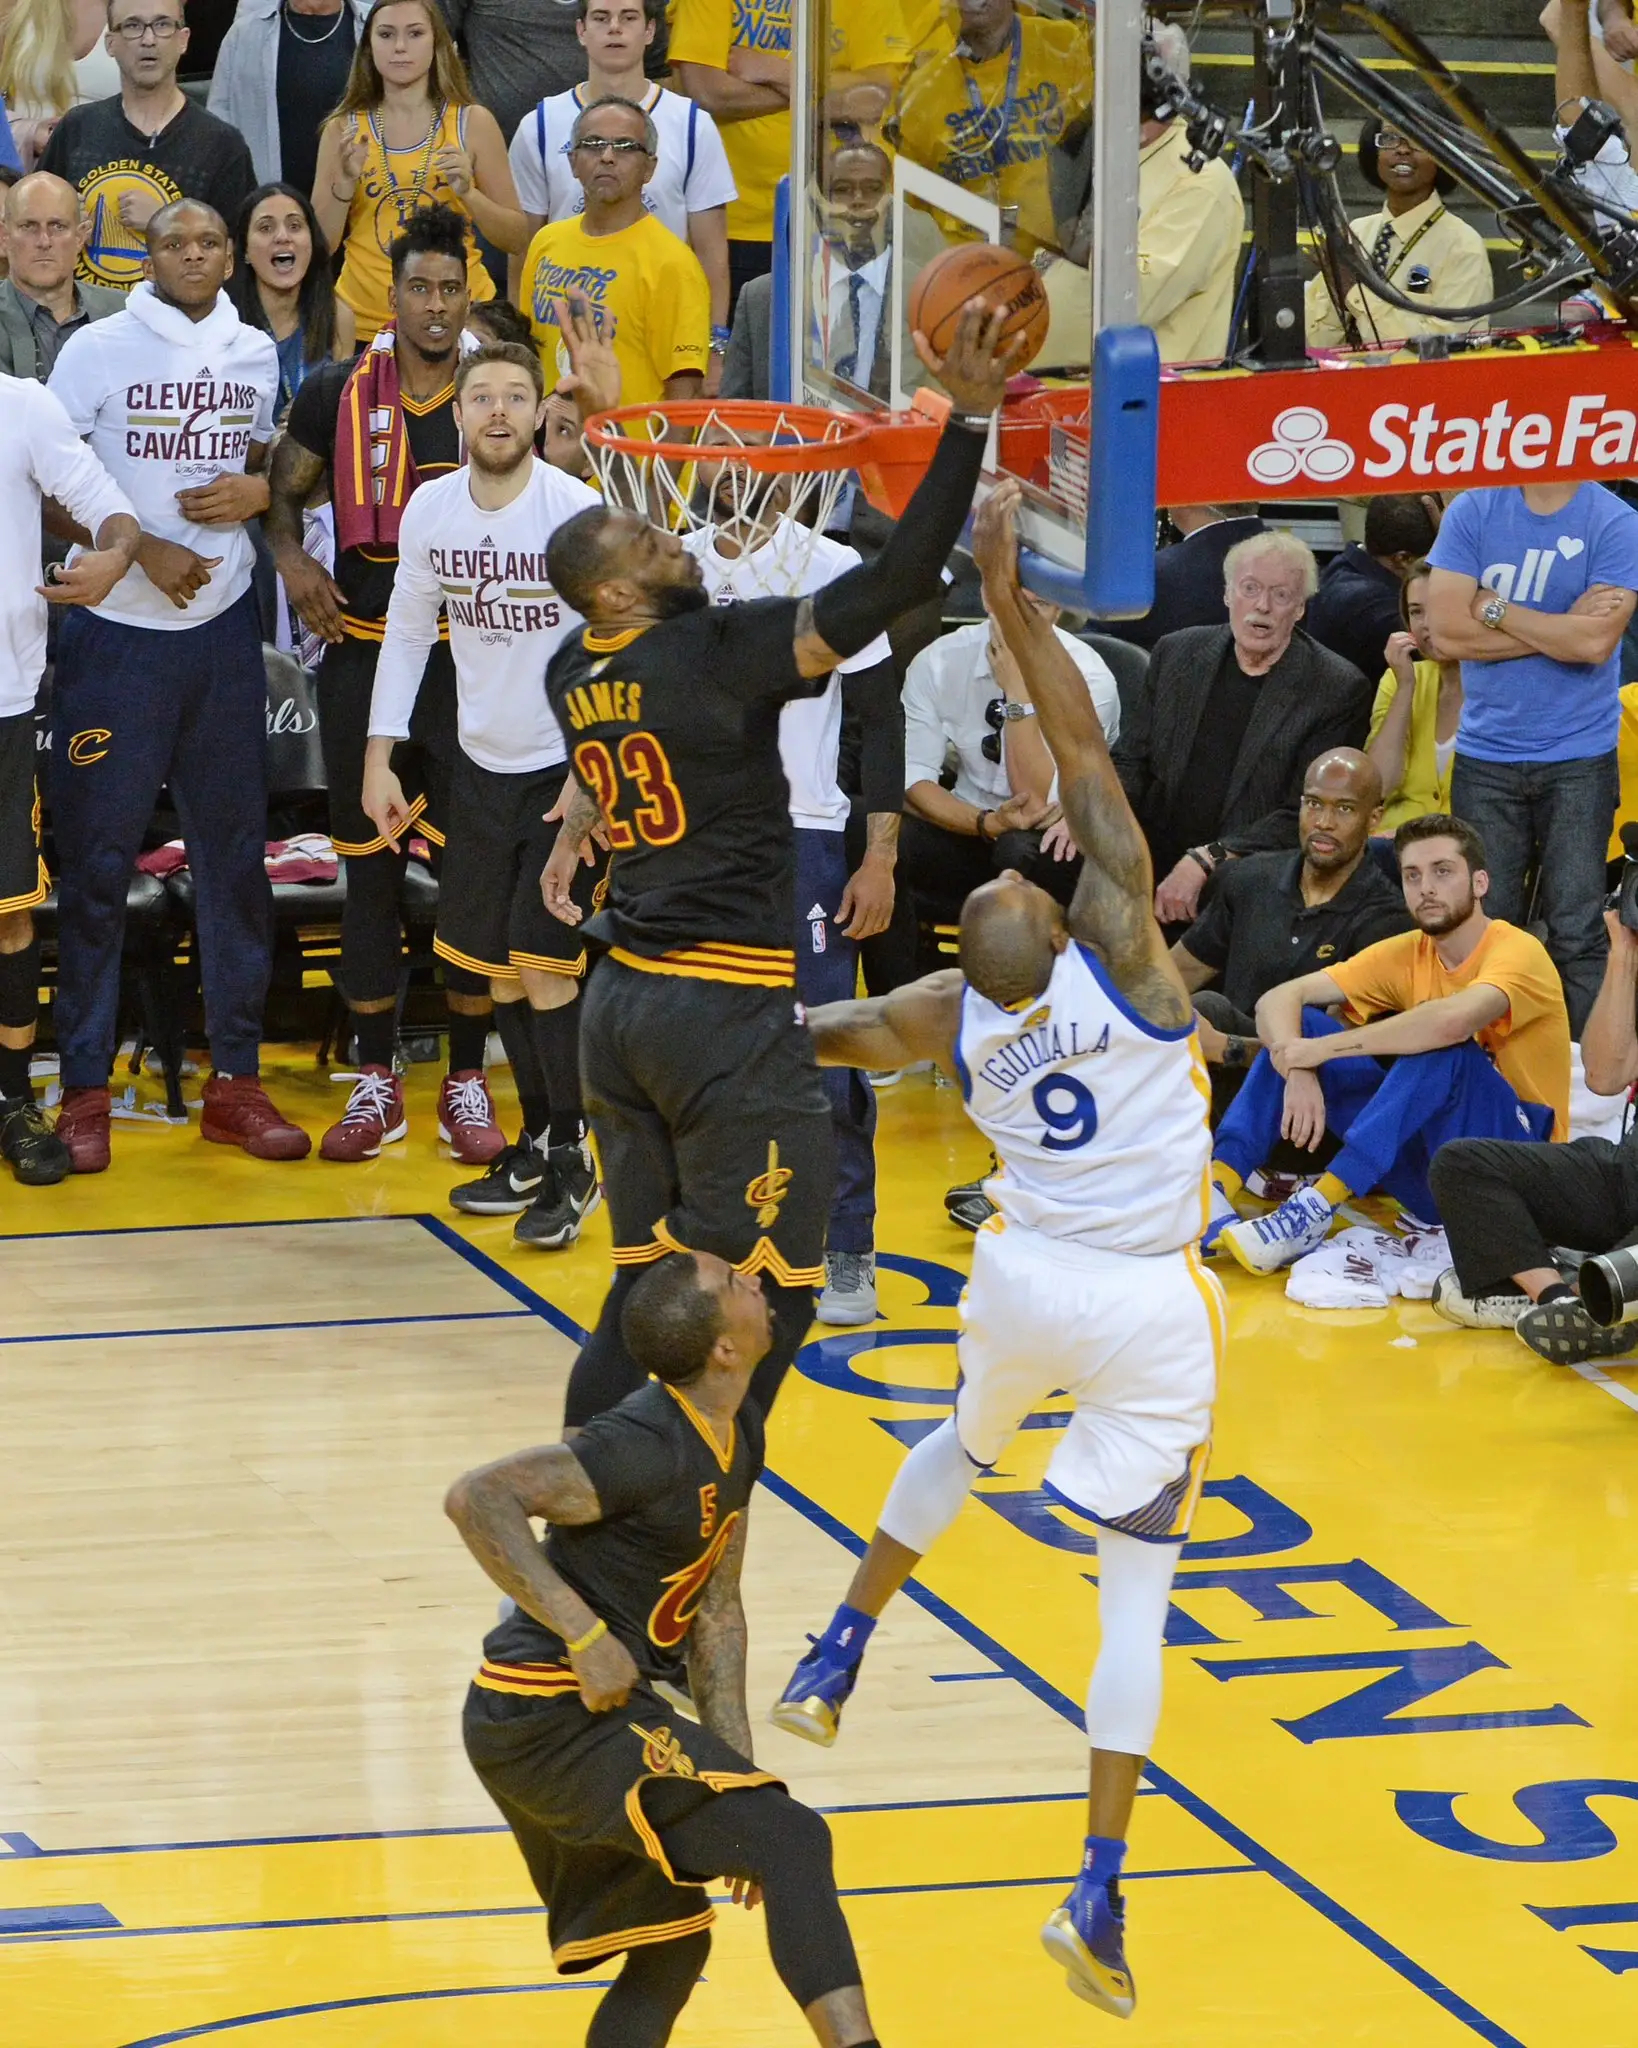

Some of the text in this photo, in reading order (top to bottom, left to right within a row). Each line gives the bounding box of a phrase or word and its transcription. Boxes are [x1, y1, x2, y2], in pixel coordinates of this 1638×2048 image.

[78, 159, 184, 202] GOLDEN STATE
[126, 381, 257, 410] CLEVELAND
[126, 430, 251, 461] CAVALIERS
[1363, 394, 1638, 478] State Fa
[429, 548, 550, 582] CLEVELAND
[1481, 548, 1558, 603] all
[448, 599, 560, 632] AVALIERS
[565, 681, 642, 730] JAMES
[574, 731, 687, 848] 23
[1032, 1072, 1098, 1151] 9
[699, 1483, 718, 1539] 5
